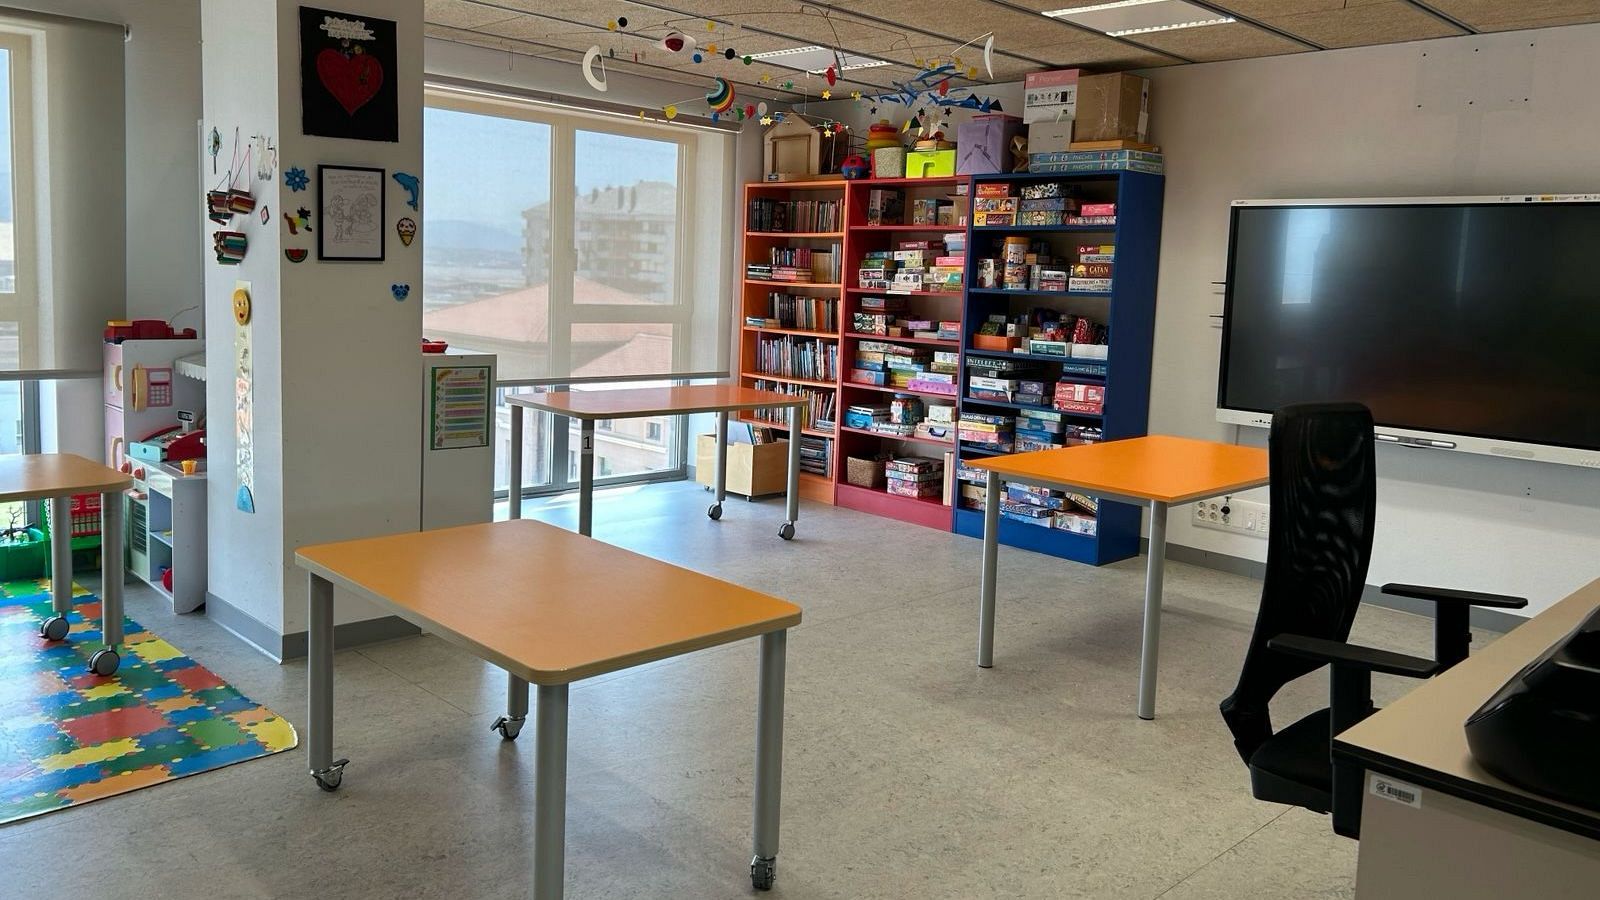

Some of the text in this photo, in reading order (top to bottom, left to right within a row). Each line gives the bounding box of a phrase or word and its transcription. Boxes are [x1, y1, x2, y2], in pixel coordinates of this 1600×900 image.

[1089, 265, 1109, 274] CATAN
[1063, 403, 1089, 411] MONOPOLY
[583, 436, 592, 449] 1
